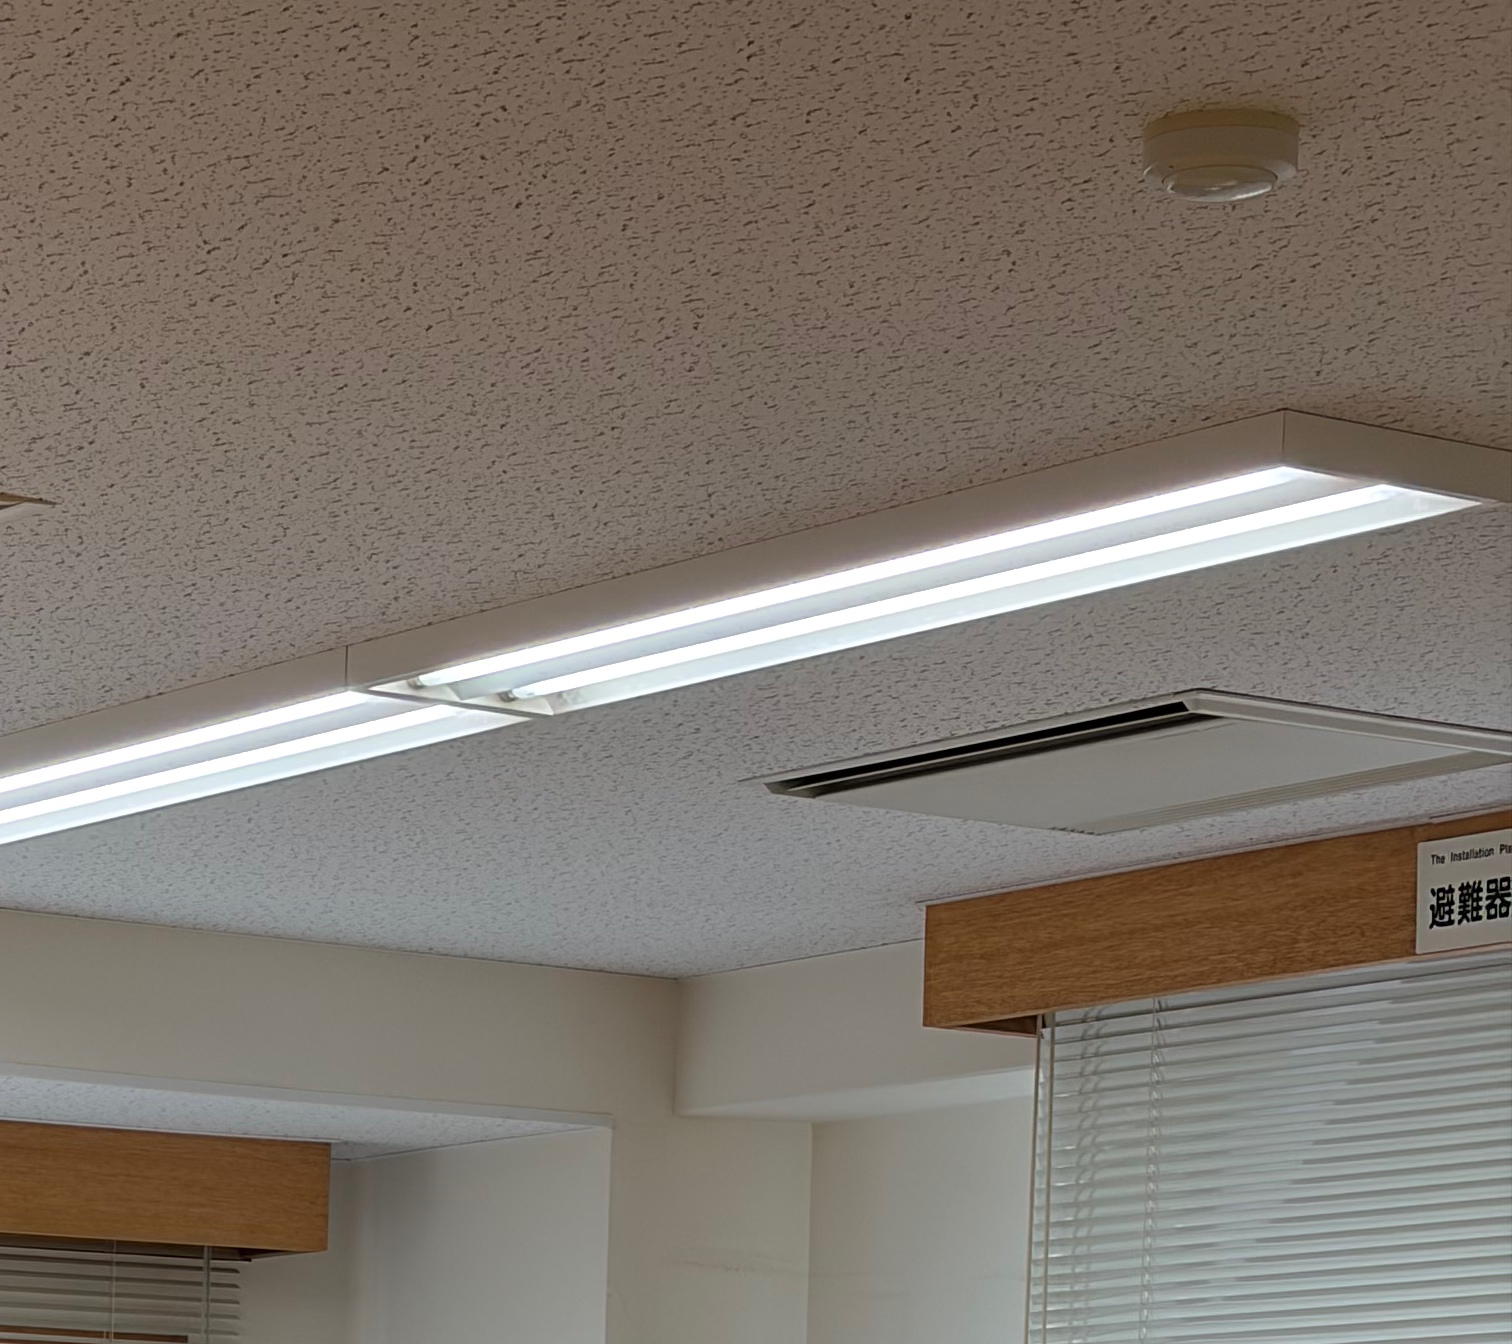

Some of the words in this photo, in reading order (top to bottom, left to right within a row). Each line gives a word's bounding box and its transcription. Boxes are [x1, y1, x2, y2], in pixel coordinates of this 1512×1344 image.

[1431, 854, 1445, 865] The
[1450, 847, 1494, 862] Installation
[1429, 876, 1512, 929] 避難器
